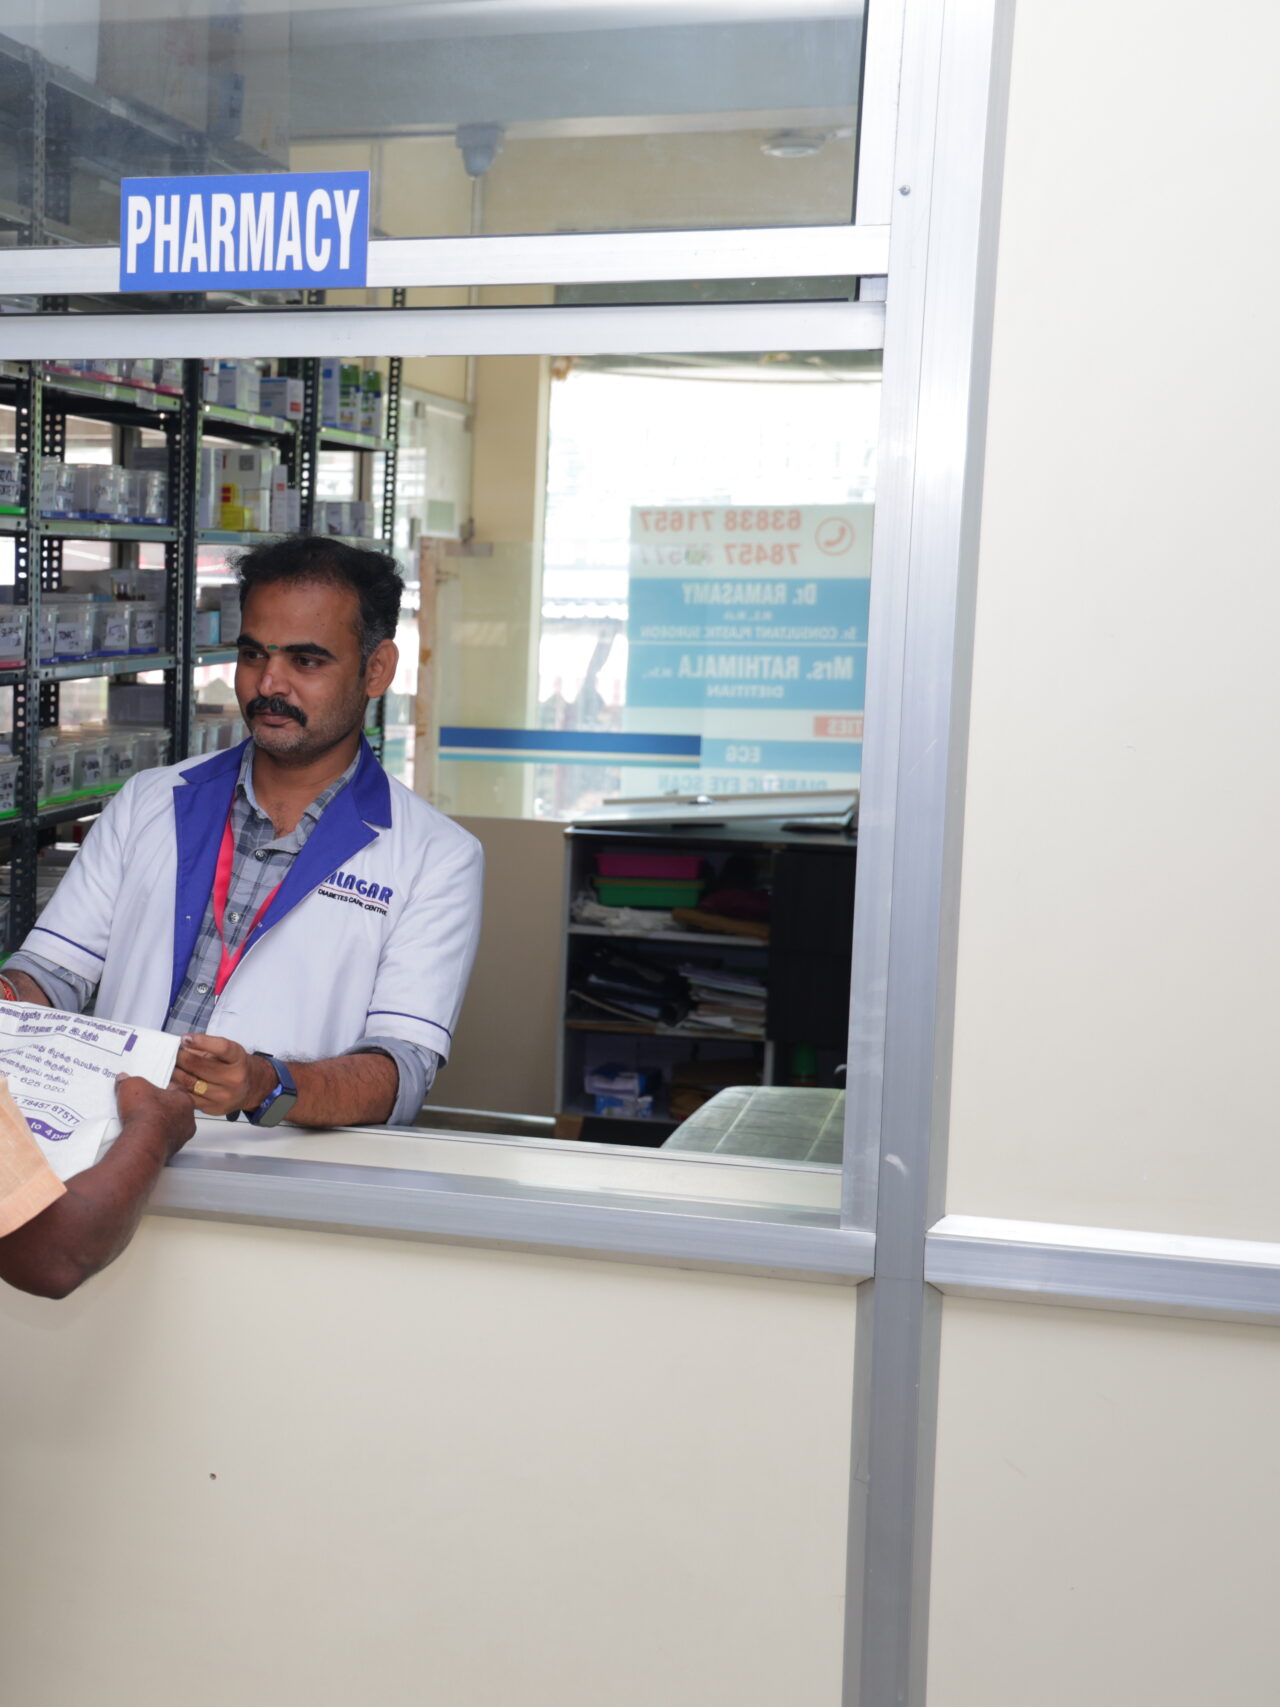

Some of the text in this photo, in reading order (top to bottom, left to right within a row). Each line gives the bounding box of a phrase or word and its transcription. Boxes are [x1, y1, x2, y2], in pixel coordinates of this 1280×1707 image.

[126, 188, 360, 274] PHARMACY
[318, 888, 388, 916] DIABETES CARE CENTRE
[20, 1078, 43, 1089] 625
[22, 1098, 80, 1125] 78457 87577
[31, 1121, 42, 1131] to
[45, 1129, 53, 1137] 4
